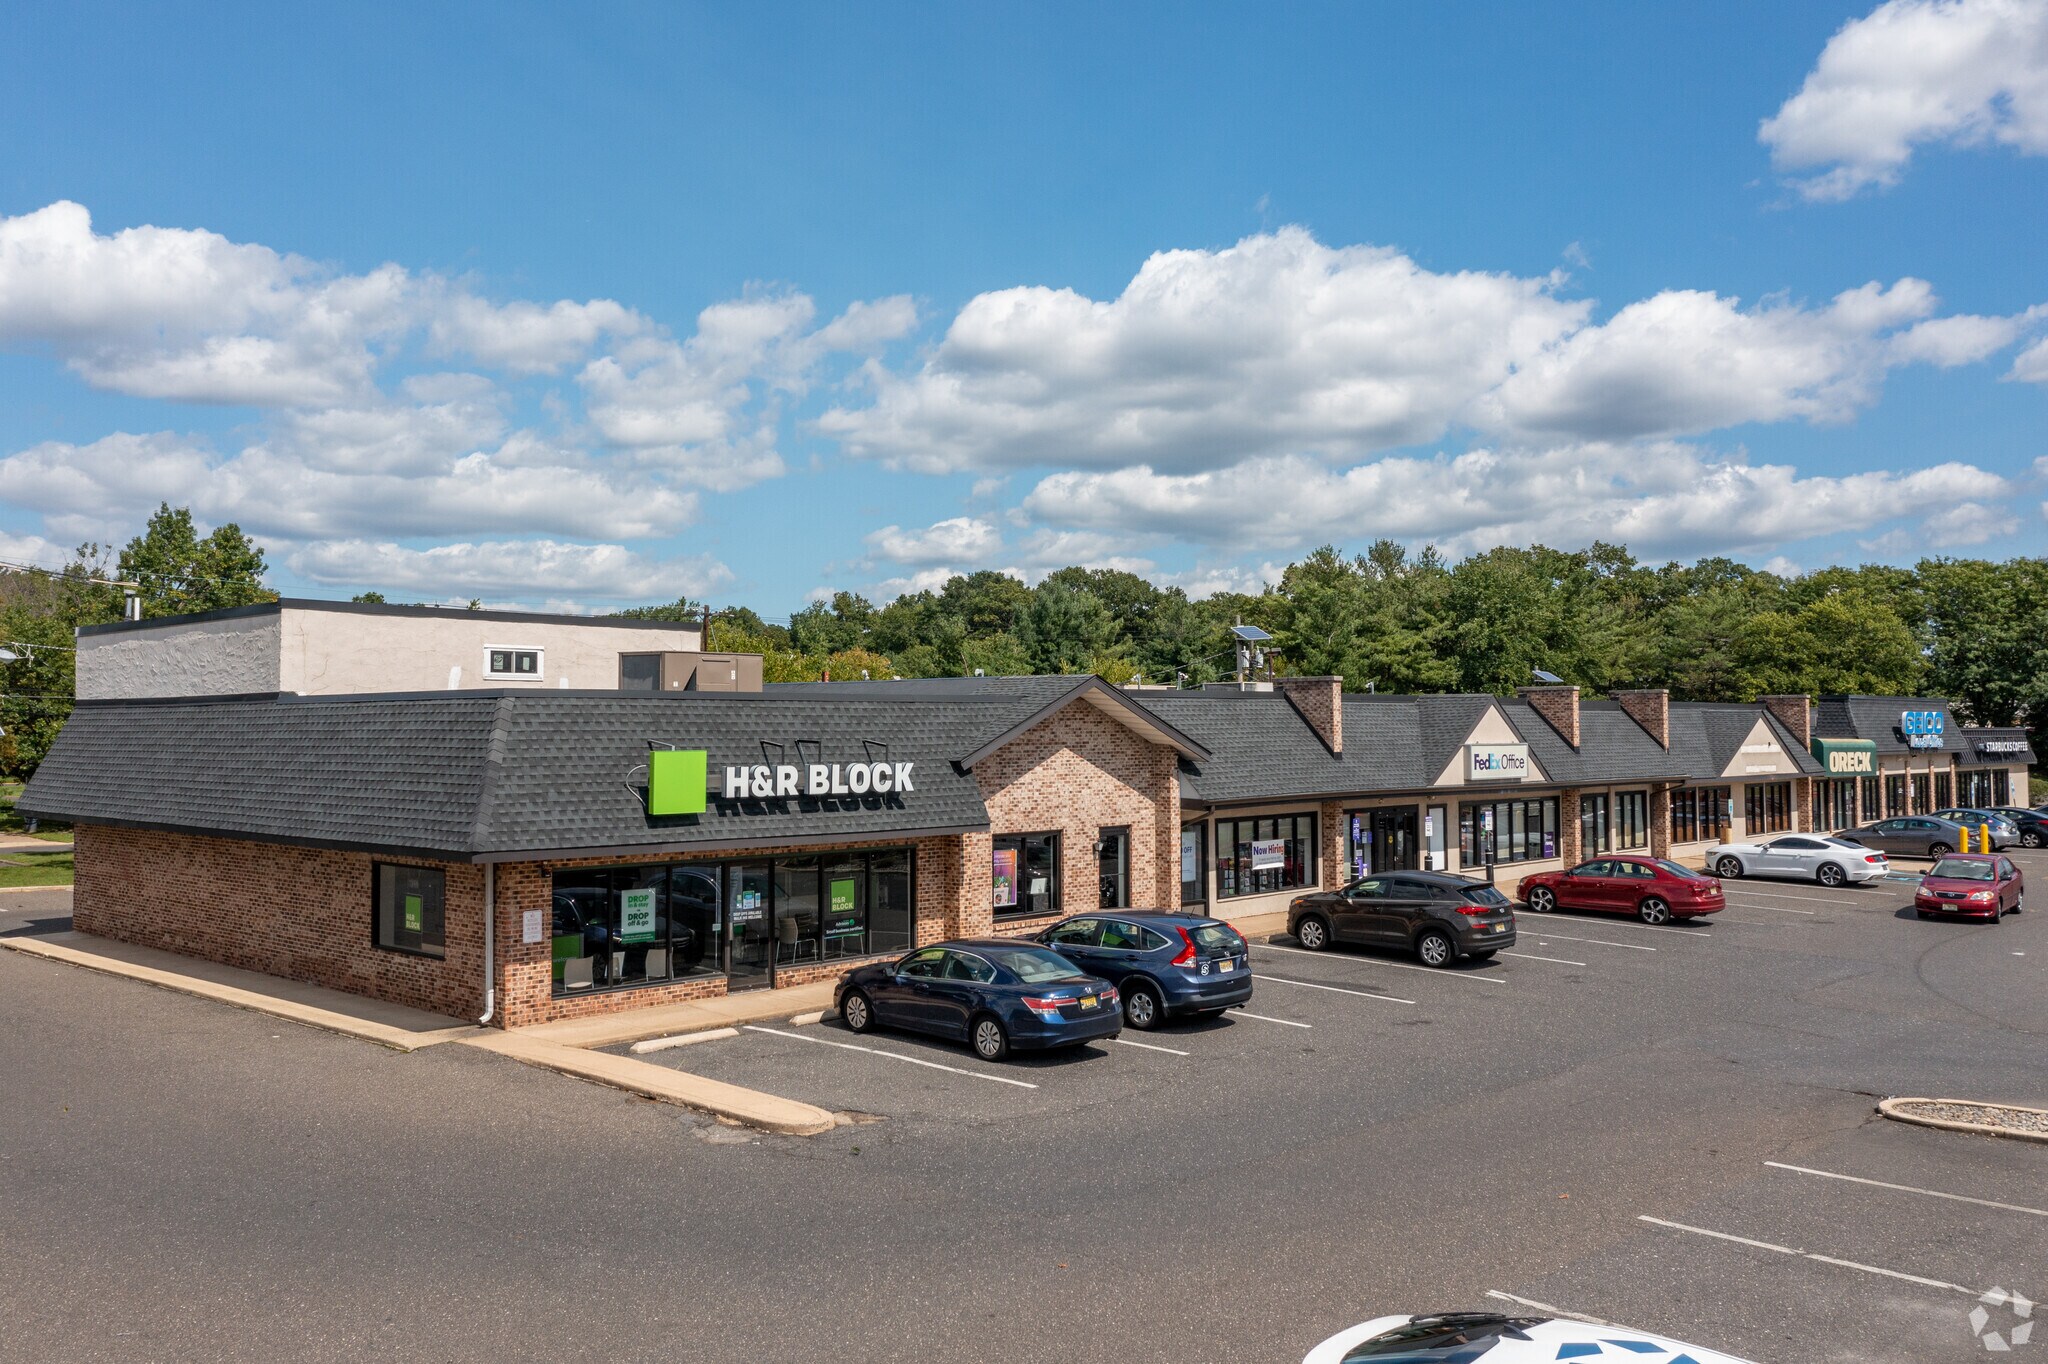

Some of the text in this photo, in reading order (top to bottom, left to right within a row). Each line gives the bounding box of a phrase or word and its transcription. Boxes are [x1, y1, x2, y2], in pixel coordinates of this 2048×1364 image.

[1905, 711, 1943, 735] GEICO
[1986, 741, 2028, 752] STARBUCKS COFFEE
[1473, 753, 1525, 770] FedEx Office
[1829, 751, 1872, 772] ORECK
[723, 762, 914, 798] H&R BLOCK
[1253, 844, 1284, 856] Now Hiring
[628, 895, 649, 903] DROP
[832, 896, 846, 904] H&R
[832, 902, 854, 911] BLOCK
[628, 912, 649, 920] DROP
